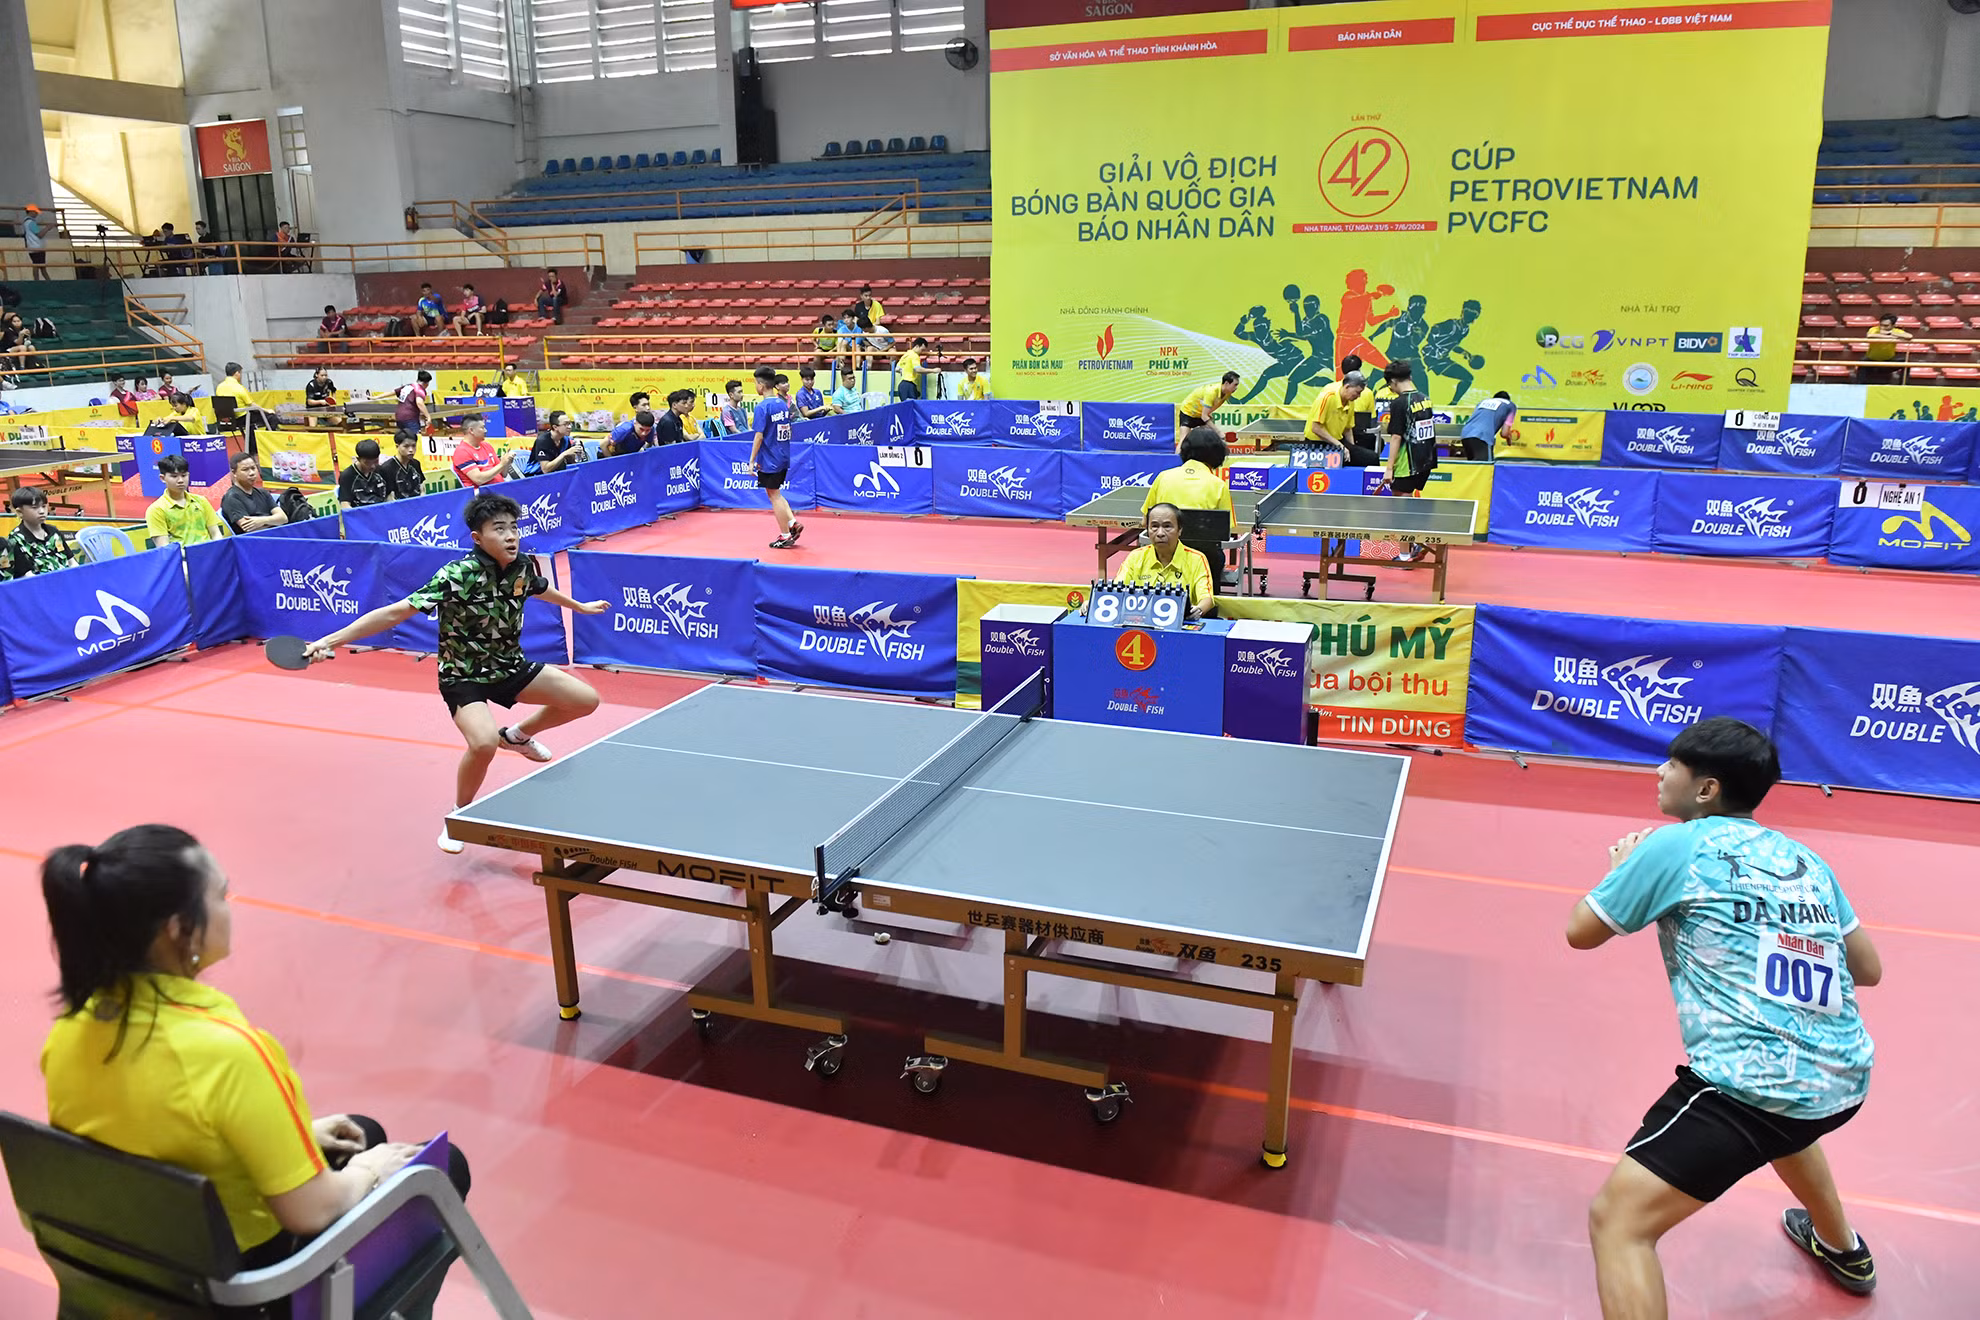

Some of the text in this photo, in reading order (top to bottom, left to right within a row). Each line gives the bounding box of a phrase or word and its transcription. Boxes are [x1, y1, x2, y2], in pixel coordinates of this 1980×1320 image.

[1085, 4, 1134, 17] SAIGON
[1532, 22, 1552, 33] CỤC
[1554, 17, 1575, 30] THỂ
[1576, 20, 1597, 32] DỤC
[1598, 15, 1619, 28] THỂ
[1620, 17, 1646, 28] THAO
[1684, 13, 1708, 26] VIỆT
[1710, 12, 1733, 23] NAM
[1338, 28, 1402, 42] BÁO NHÂN DÂN
[1050, 52, 1061, 61] SỞ
[1062, 51, 1078, 61] VĂN
[1079, 49, 1095, 60] HÓA
[1097, 48, 1108, 58] VÀ
[1109, 44, 1125, 57] THỂ
[1127, 46, 1148, 55] THAO
[1171, 42, 1199, 53] KHÁNH
[1200, 40, 1218, 51] HÒA
[1450, 140, 1516, 171] CÚP
[223, 161, 252, 173] SAIGON
[1099, 151, 1278, 184] GIẢI VÔ ĐỊCH
[1327, 138, 1391, 197] 42
[1010, 178, 1276, 217] BÓNG BÀN QUỐC GIA
[1448, 175, 1700, 203] PETROVIETNAM
[1077, 209, 1275, 243] BÁO NHÂN DÂN
[1447, 209, 1550, 234] PVCFC
[1124, 306, 1149, 314] CHÍNH
[1620, 305, 1641, 313] NHÀ
[1643, 305, 1658, 313] TÀI
[1544, 334, 1584, 349] BCG
[1617, 338, 1669, 347] VNPT
[1678, 338, 1709, 349] BIDV
[1160, 346, 1179, 356] NPK
[1078, 360, 1133, 370] PETROVIETNAM
[1149, 358, 1190, 369] PHÚ MỸ
[1670, 383, 1713, 391] LI-NING
[1067, 401, 1074, 415] 0
[1211, 409, 1242, 426] PHÚ
[1735, 412, 1744, 427] 0
[926, 426, 976, 436] DOUBLE FISH
[1010, 426, 1061, 437] DOUBLE FISH
[1103, 430, 1157, 440] DOUBLE FISH
[1418, 426, 1433, 439] 077
[154, 439, 162, 453] 8
[429, 437, 437, 454] 0
[1627, 442, 1694, 454] DOUBLE FISH
[1746, 443, 1816, 457] DOUBLE FISH
[914, 448, 923, 466] 0
[1292, 451, 1340, 468] 12 00 10
[1870, 452, 1943, 465] DOUBLE FISH
[666, 481, 690, 497] DOUBLE
[724, 477, 758, 490] DOUBLE
[1312, 474, 1325, 491] 5
[853, 490, 900, 499] MOFIT
[960, 485, 1033, 500] DOUBLE FISH
[1853, 484, 1867, 505] 0
[1904, 492, 1915, 505] AN
[591, 493, 637, 514] DOUBLE FISH
[547, 515, 562, 530] FISH
[1525, 510, 1619, 527] DOUBLE FISH
[1691, 519, 1792, 538] DOUBLE FISH
[1878, 538, 1970, 550] MOFIT
[276, 593, 359, 615] DOUBLE FISH
[1094, 595, 1178, 627] 8 9
[614, 613, 718, 639] DOUBLE FISH
[77, 628, 150, 657] MOFIT
[799, 630, 925, 661] DOUBLE FISH
[1390, 616, 1455, 661] MỸ
[984, 644, 1045, 656] Double FISH
[1121, 634, 1145, 665] 4
[1230, 664, 1297, 677] Double FISH
[1349, 669, 1448, 696] bội thu
[1107, 700, 1165, 715] DOUBLE FISH
[1531, 689, 1703, 724] DOUBLE FISH
[1336, 715, 1451, 738] TIN DÙNG
[1850, 715, 1946, 743] DOUBLE
[590, 853, 638, 869] Double FISH
[658, 859, 784, 893] MOFIT
[1733, 896, 1771, 924] ĐÀ
[967, 909, 1105, 946] 世乒赛器材供应商
[1241, 953, 1282, 972] 235
[1765, 952, 1834, 1008] 007
